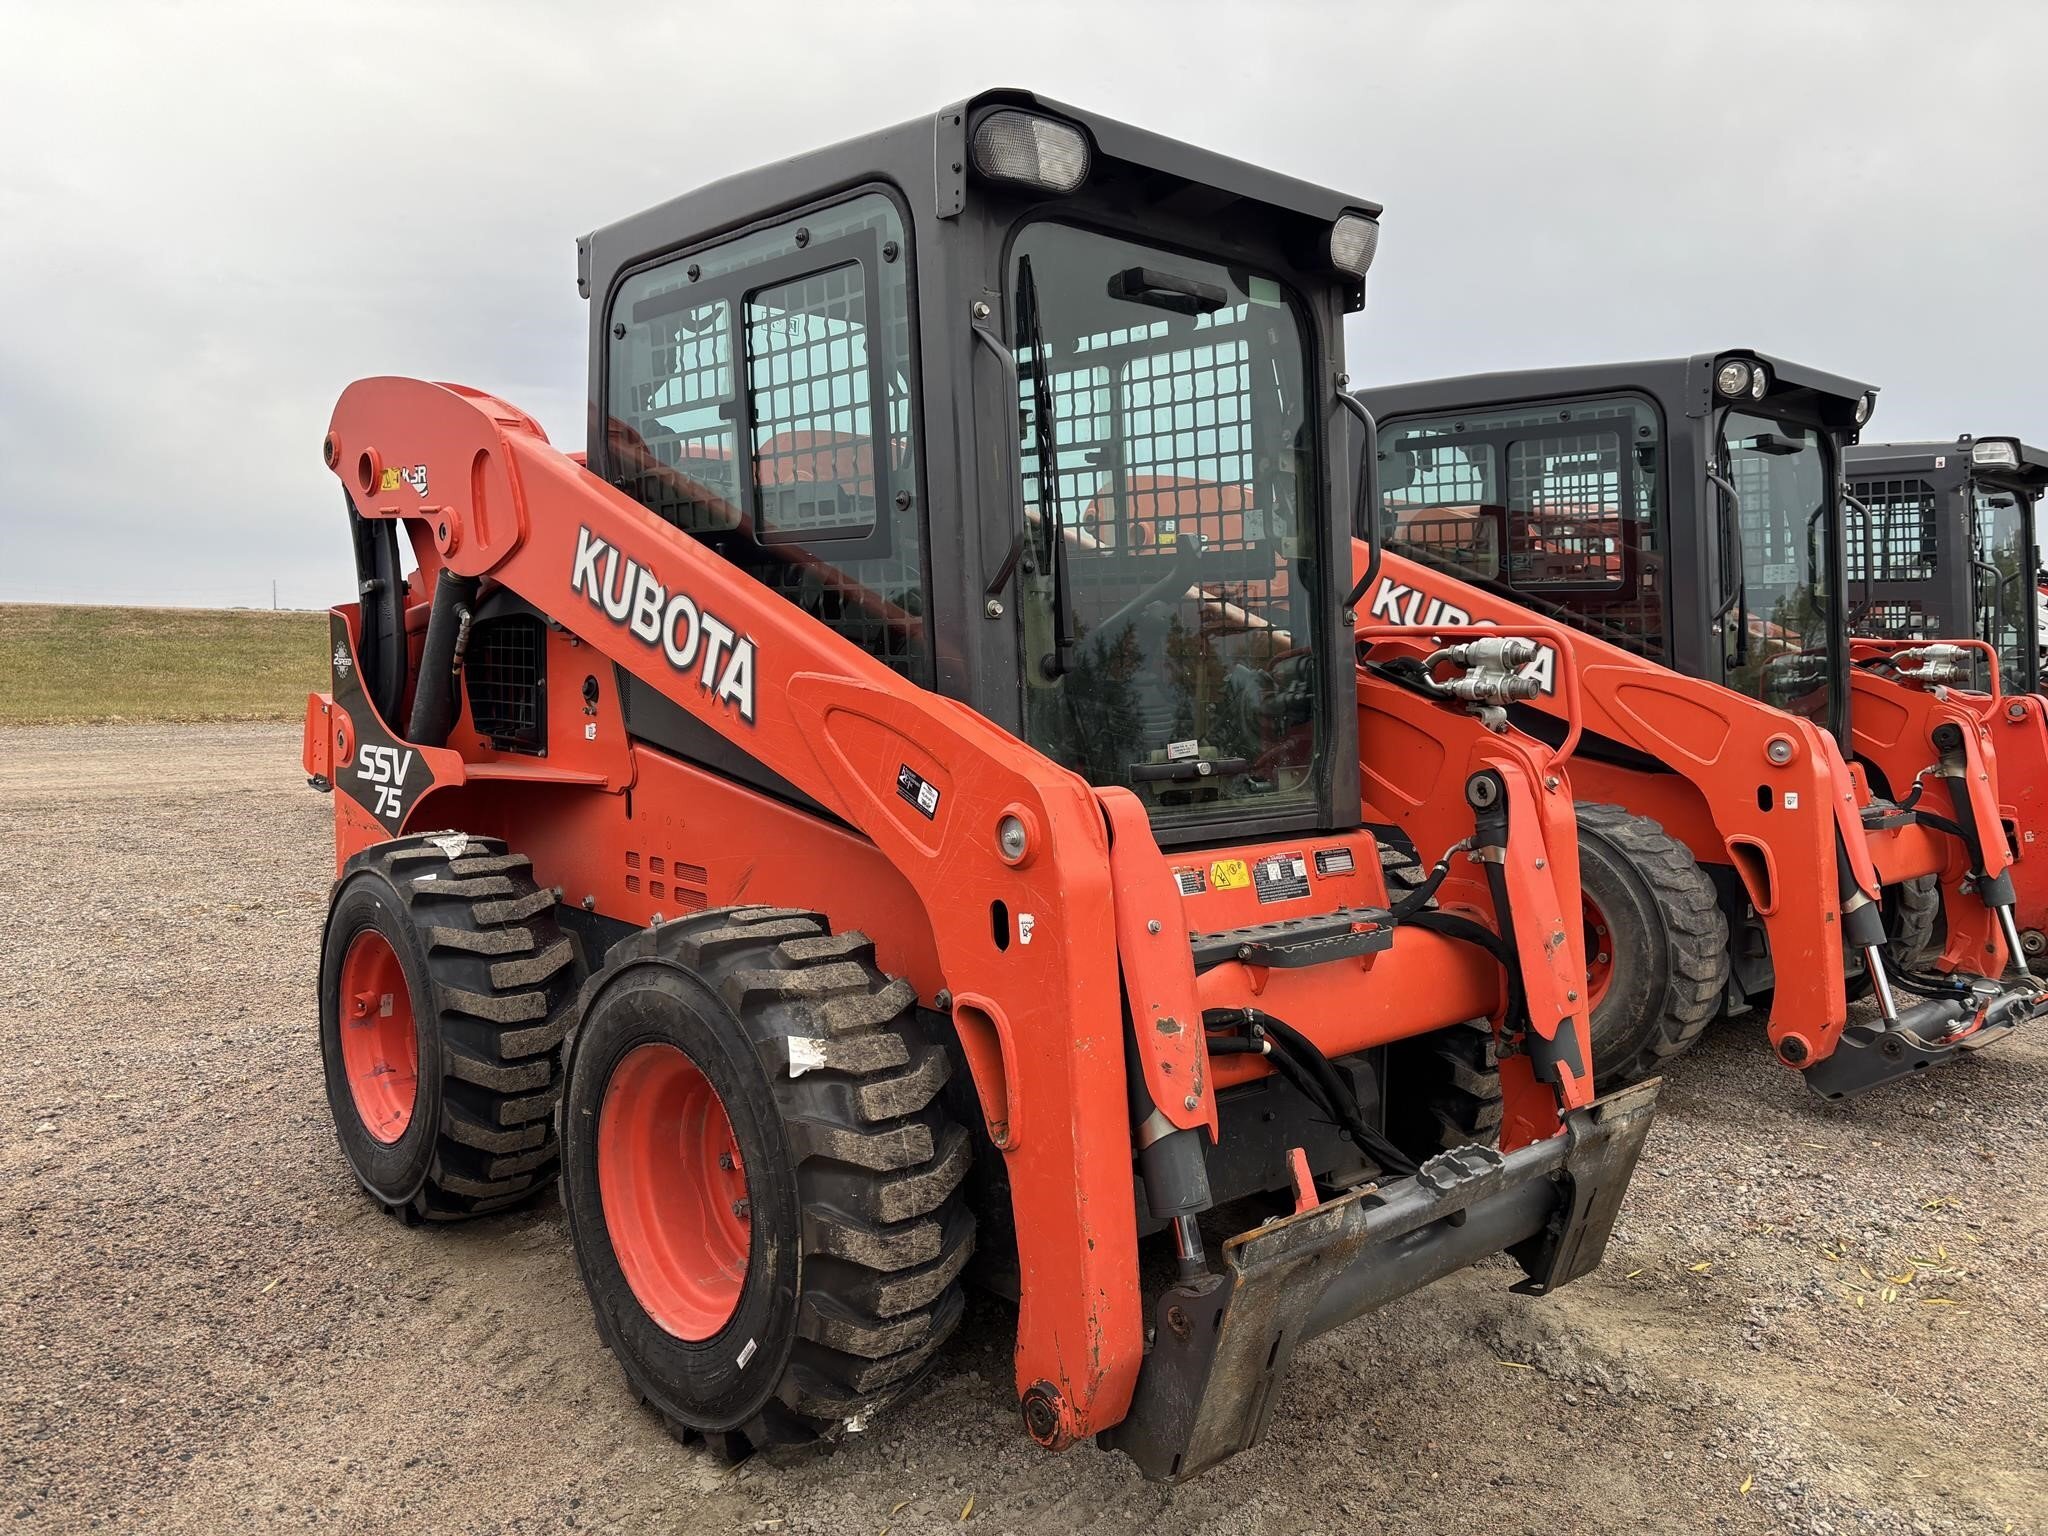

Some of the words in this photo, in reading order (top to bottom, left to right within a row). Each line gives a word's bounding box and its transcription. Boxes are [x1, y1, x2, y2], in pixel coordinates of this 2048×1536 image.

[572, 526, 753, 721] KUBOTA
[357, 744, 413, 786] SSV
[374, 784, 402, 819] 75
